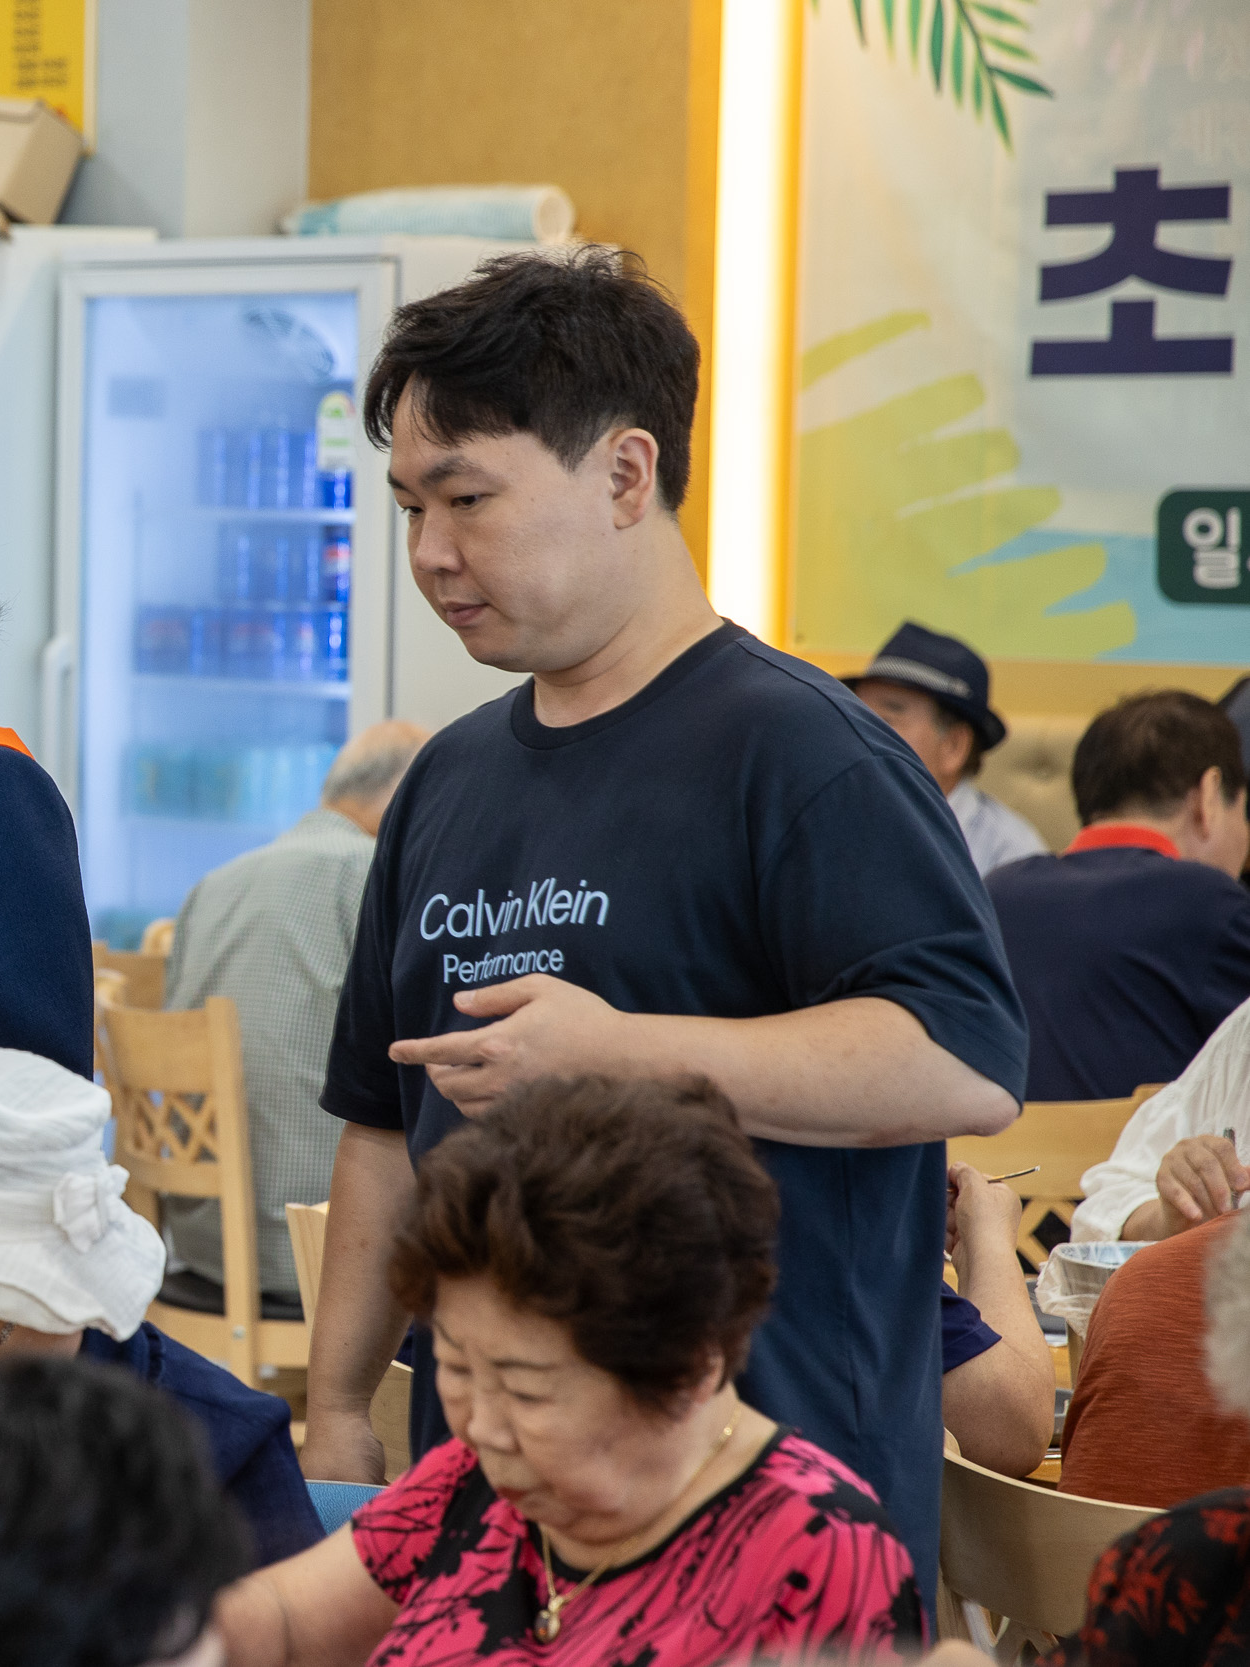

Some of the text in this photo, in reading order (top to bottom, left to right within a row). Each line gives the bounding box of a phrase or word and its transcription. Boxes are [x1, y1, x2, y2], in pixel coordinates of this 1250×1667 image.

[1030, 167, 1234, 376] 초
[420, 877, 610, 940] Calvin Klein
[443, 949, 565, 984] Performance
